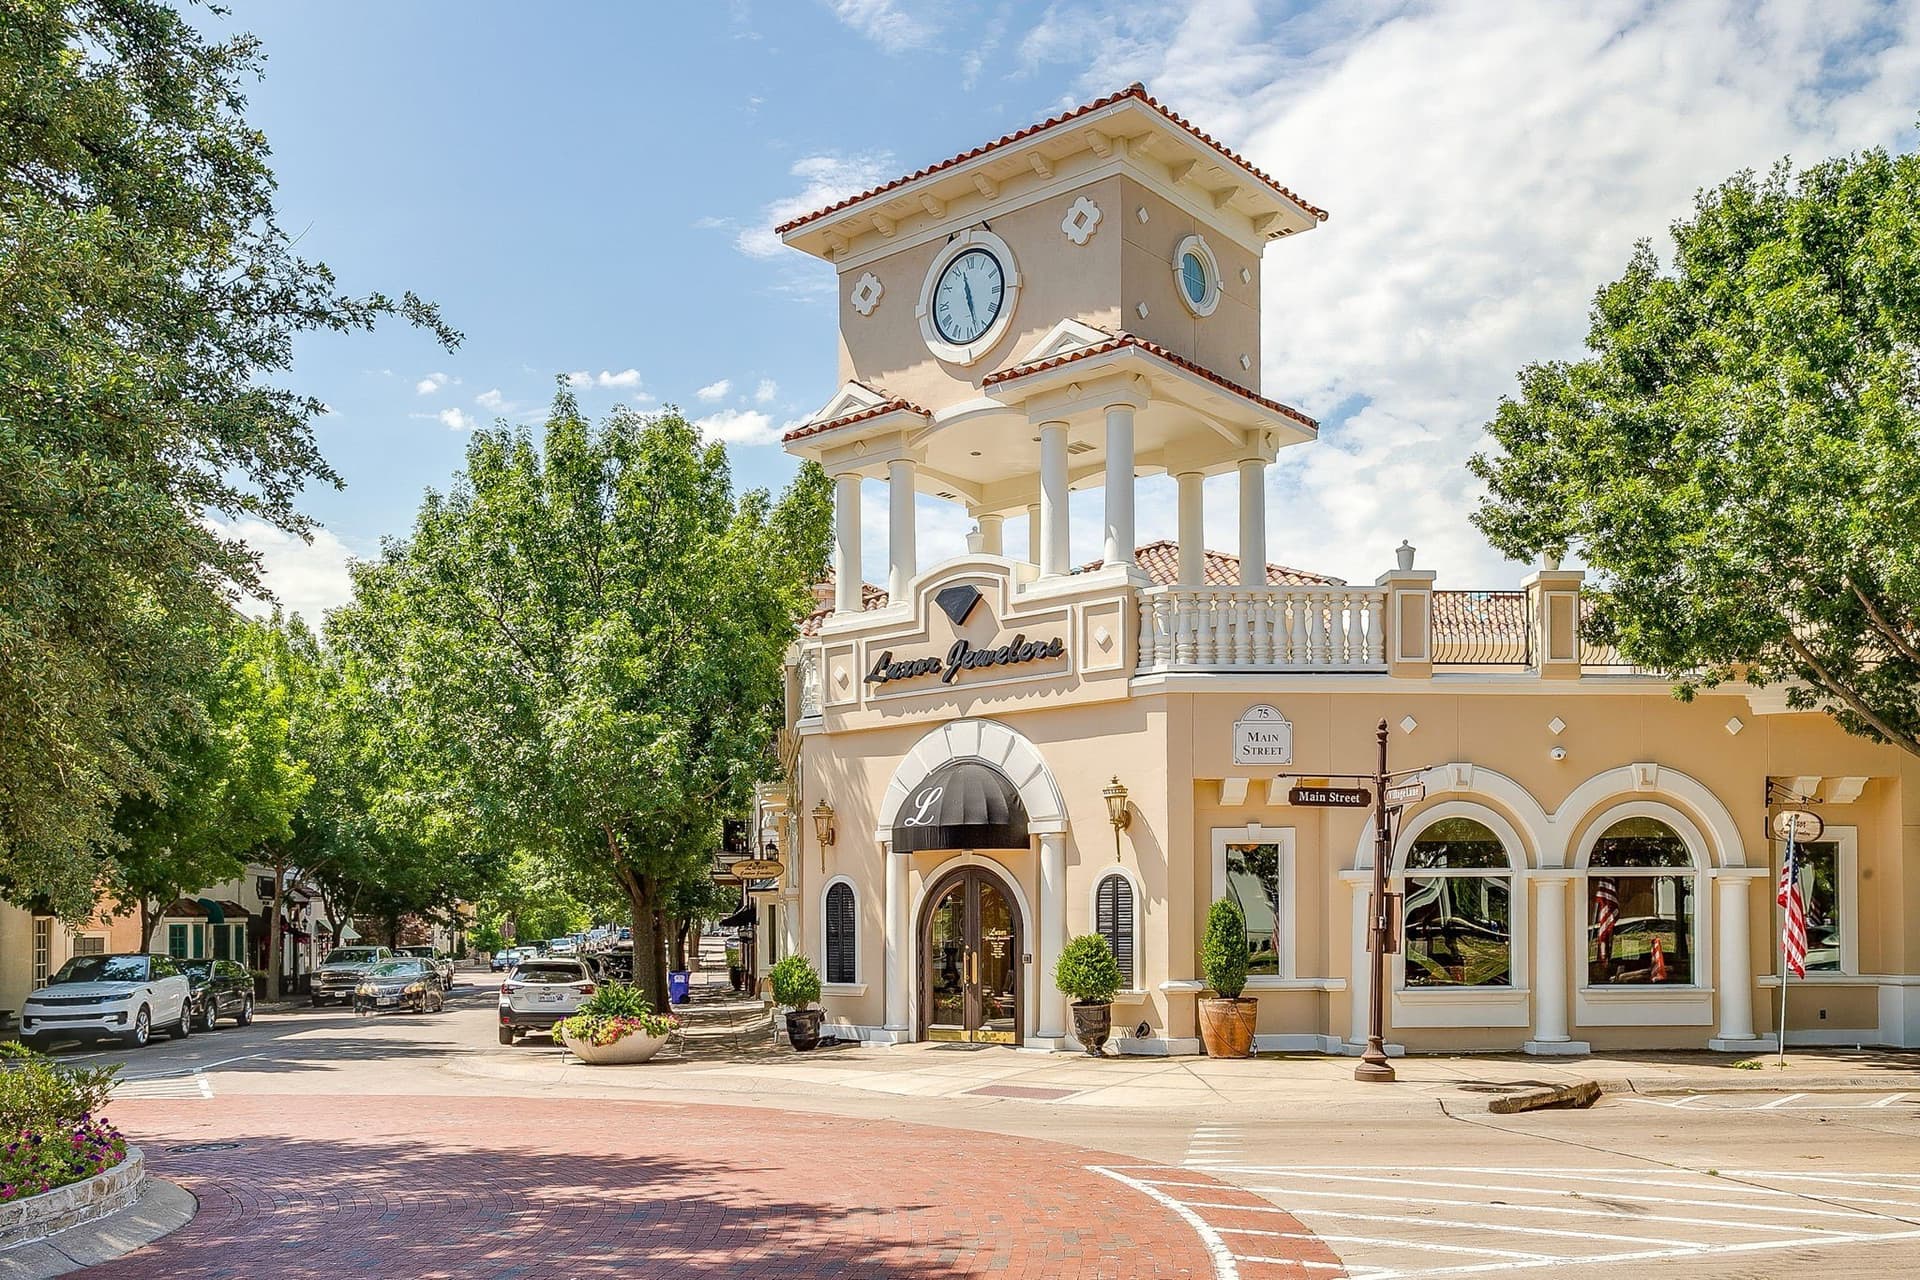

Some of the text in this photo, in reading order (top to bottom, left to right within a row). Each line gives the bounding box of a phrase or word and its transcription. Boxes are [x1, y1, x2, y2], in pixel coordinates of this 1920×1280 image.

[864, 633, 1065, 684] Luxor Jewelers
[1257, 709, 1270, 719] 75
[1455, 767, 1469, 786] L
[1640, 767, 1654, 786] L
[904, 786, 943, 827] L
[1299, 791, 1360, 803] Main Street
